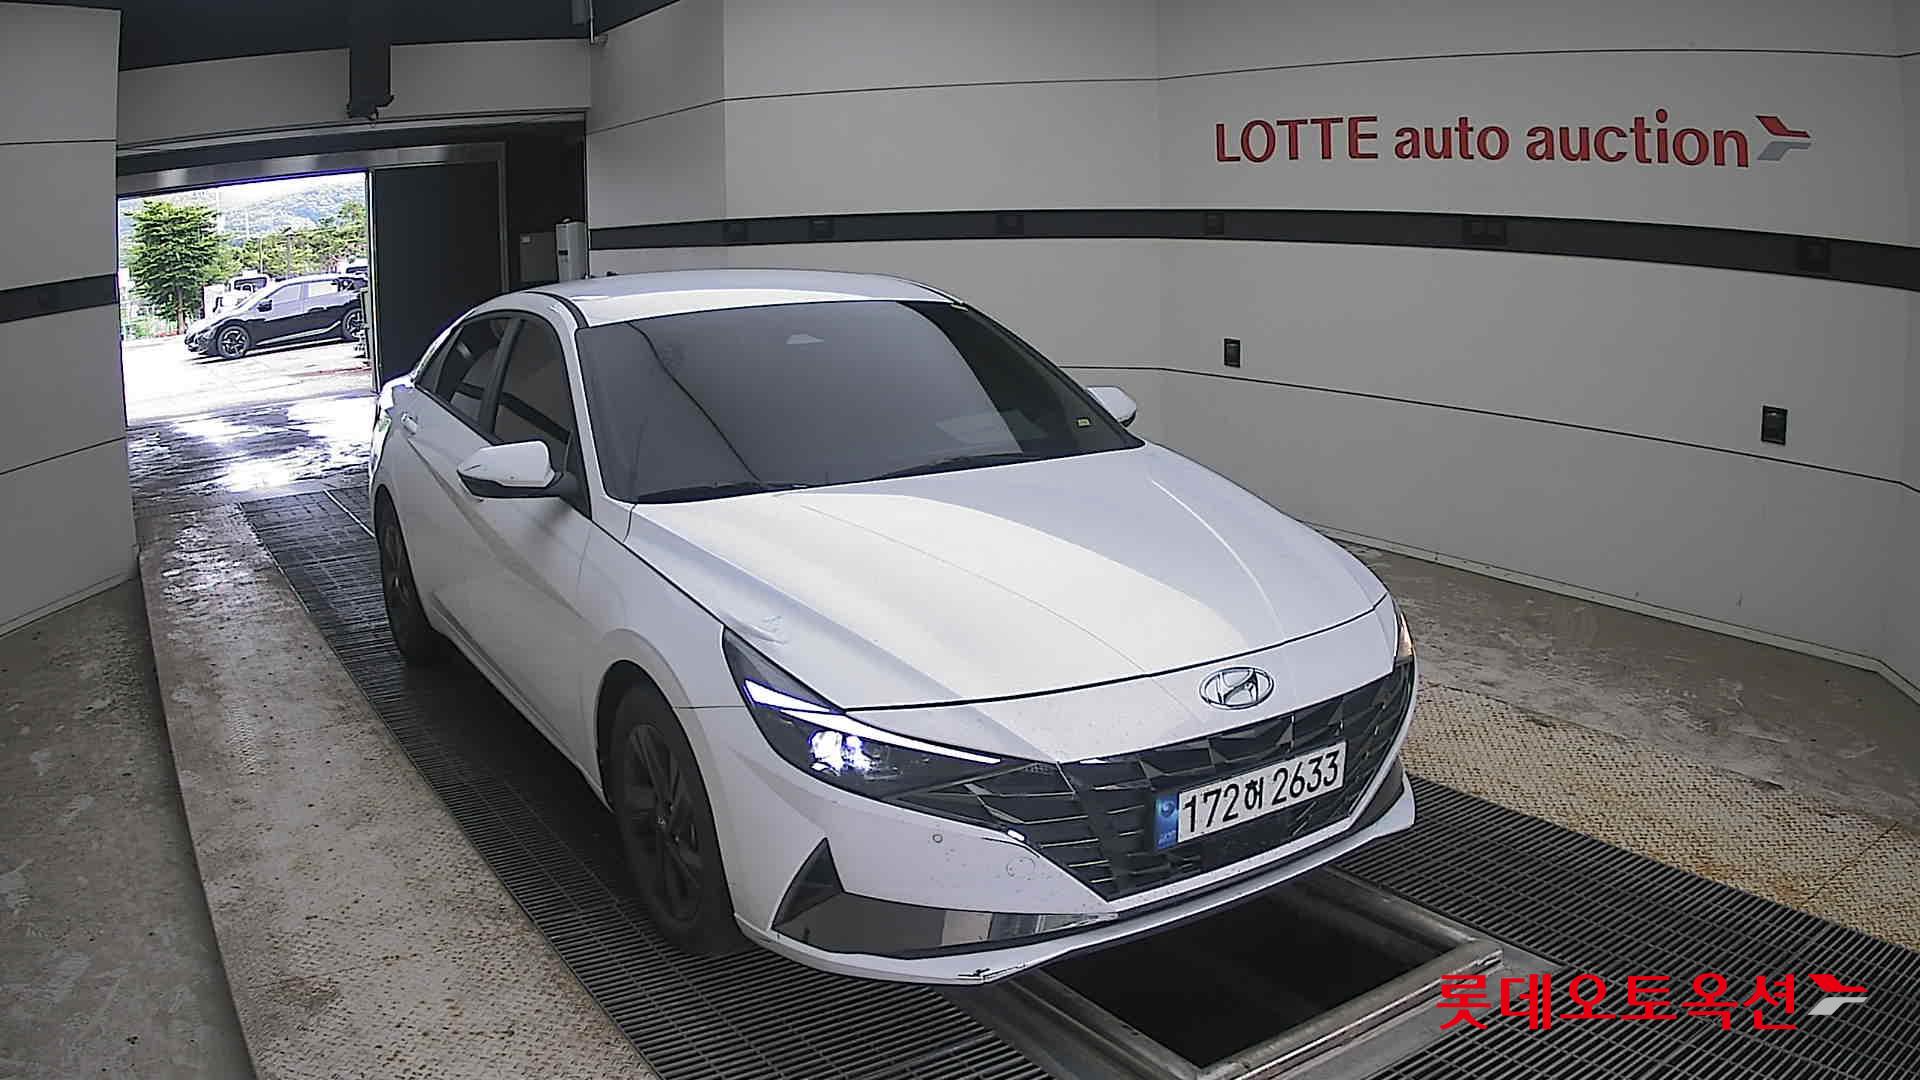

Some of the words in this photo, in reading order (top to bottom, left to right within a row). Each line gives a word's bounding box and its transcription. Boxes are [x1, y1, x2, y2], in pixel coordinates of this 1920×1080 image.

[1215, 116, 1379, 163] LOTTE
[1393, 117, 1510, 161] auto
[1526, 108, 1750, 168] auction
[1182, 777, 1265, 833] 172허
[1271, 749, 1341, 806] 2633
